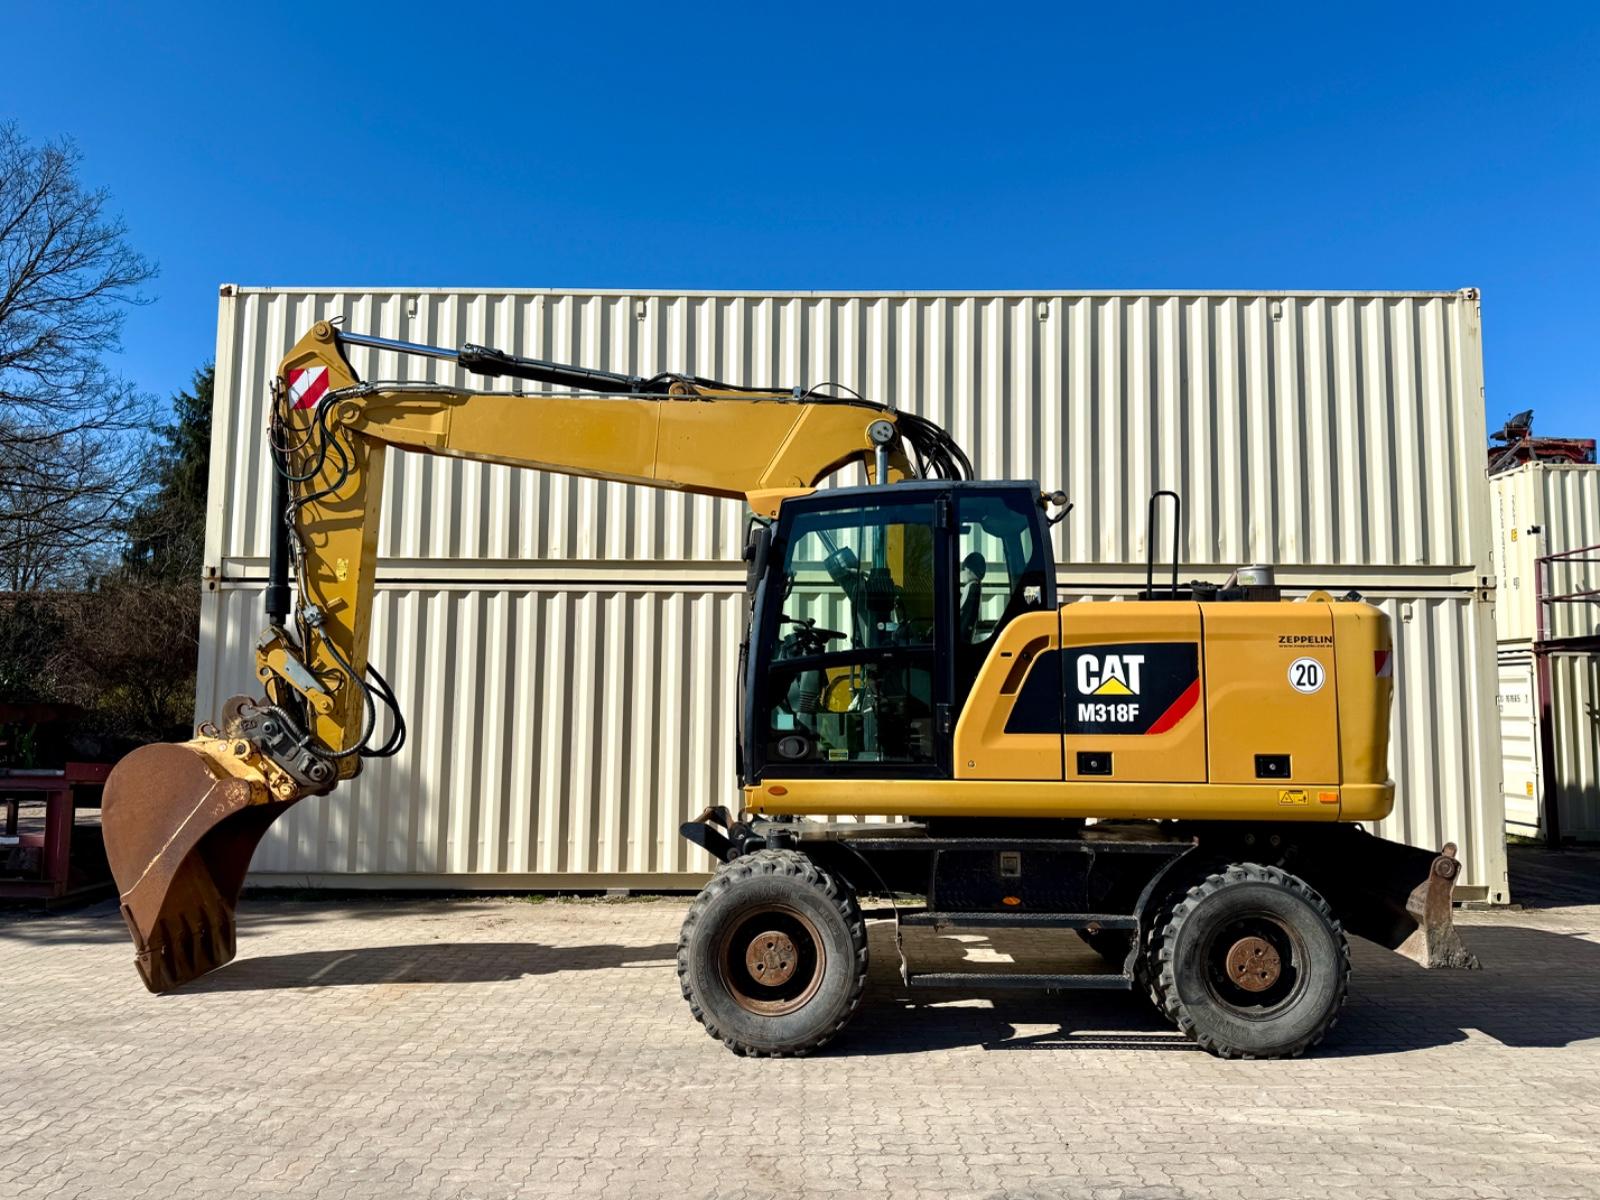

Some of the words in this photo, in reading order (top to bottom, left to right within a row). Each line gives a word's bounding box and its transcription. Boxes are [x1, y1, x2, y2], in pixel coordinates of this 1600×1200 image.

[1278, 635, 1333, 644] ZEPPELIN
[1076, 653, 1145, 696] CAT
[1295, 663, 1318, 687] 20
[1078, 703, 1140, 722] M318F
